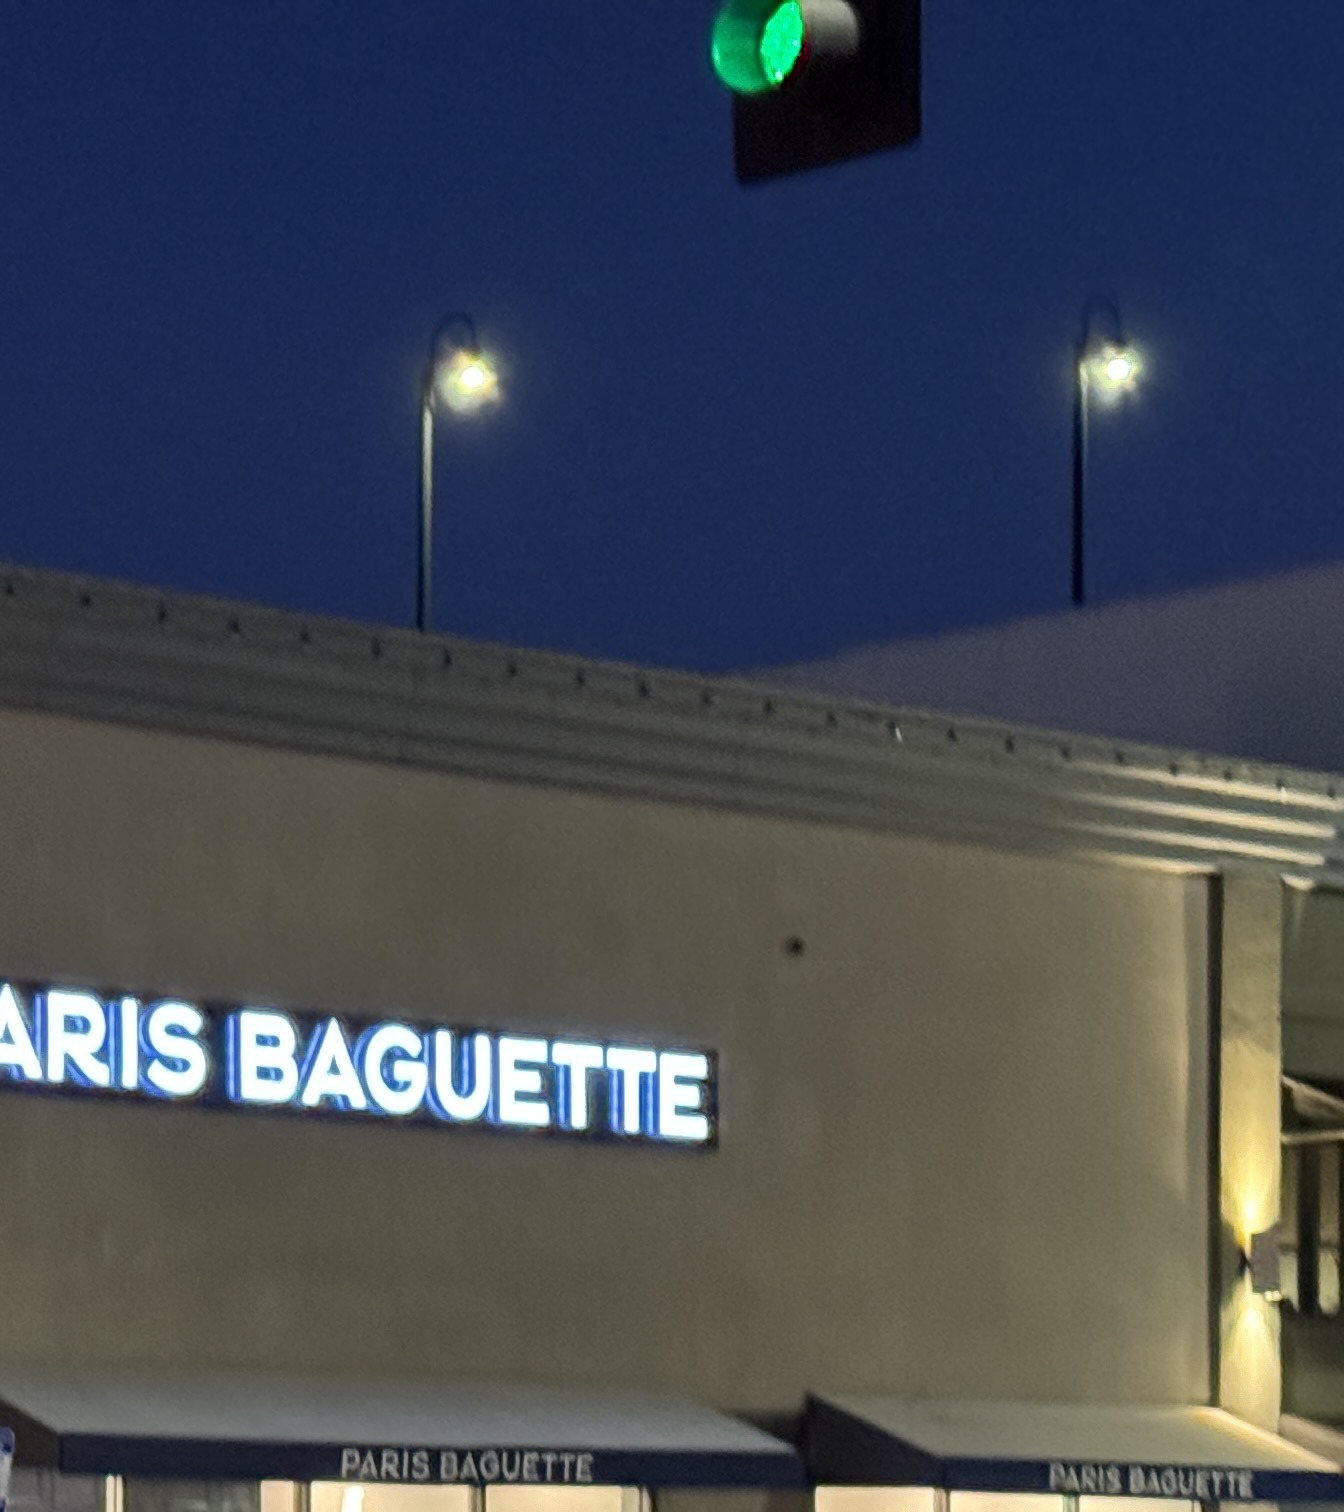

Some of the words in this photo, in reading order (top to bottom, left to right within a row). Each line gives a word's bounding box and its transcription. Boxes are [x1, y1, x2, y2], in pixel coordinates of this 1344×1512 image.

[229, 1010, 712, 1142] BAGUETTE
[340, 1447, 431, 1481] PARIS
[439, 1450, 594, 1483] BAGUETTE
